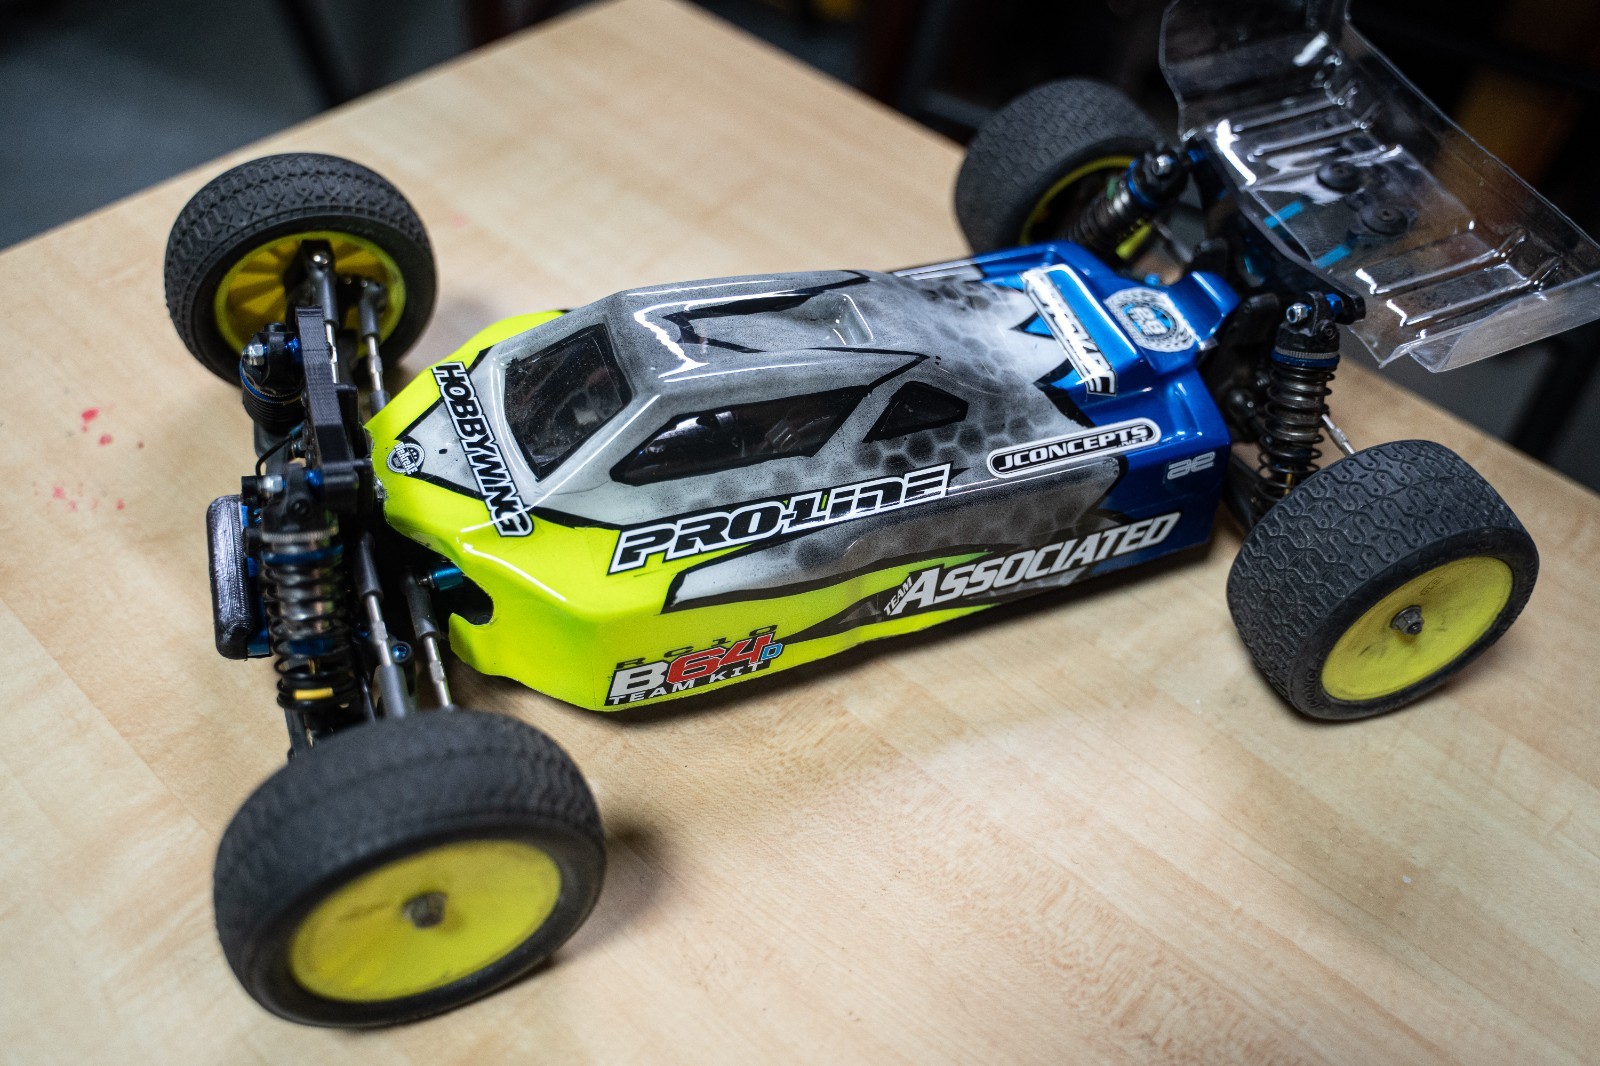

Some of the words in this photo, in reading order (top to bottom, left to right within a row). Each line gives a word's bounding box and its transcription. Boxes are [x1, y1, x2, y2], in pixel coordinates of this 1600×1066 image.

[432, 362, 534, 538] HOBBYWING
[998, 425, 1149, 471] JCONCEPTS
[889, 511, 1182, 616] ASSOCIATED
[883, 576, 914, 616] TEAM
[616, 624, 778, 670] RC10
[609, 678, 695, 705] TEAM
[708, 660, 764, 684] KIT
